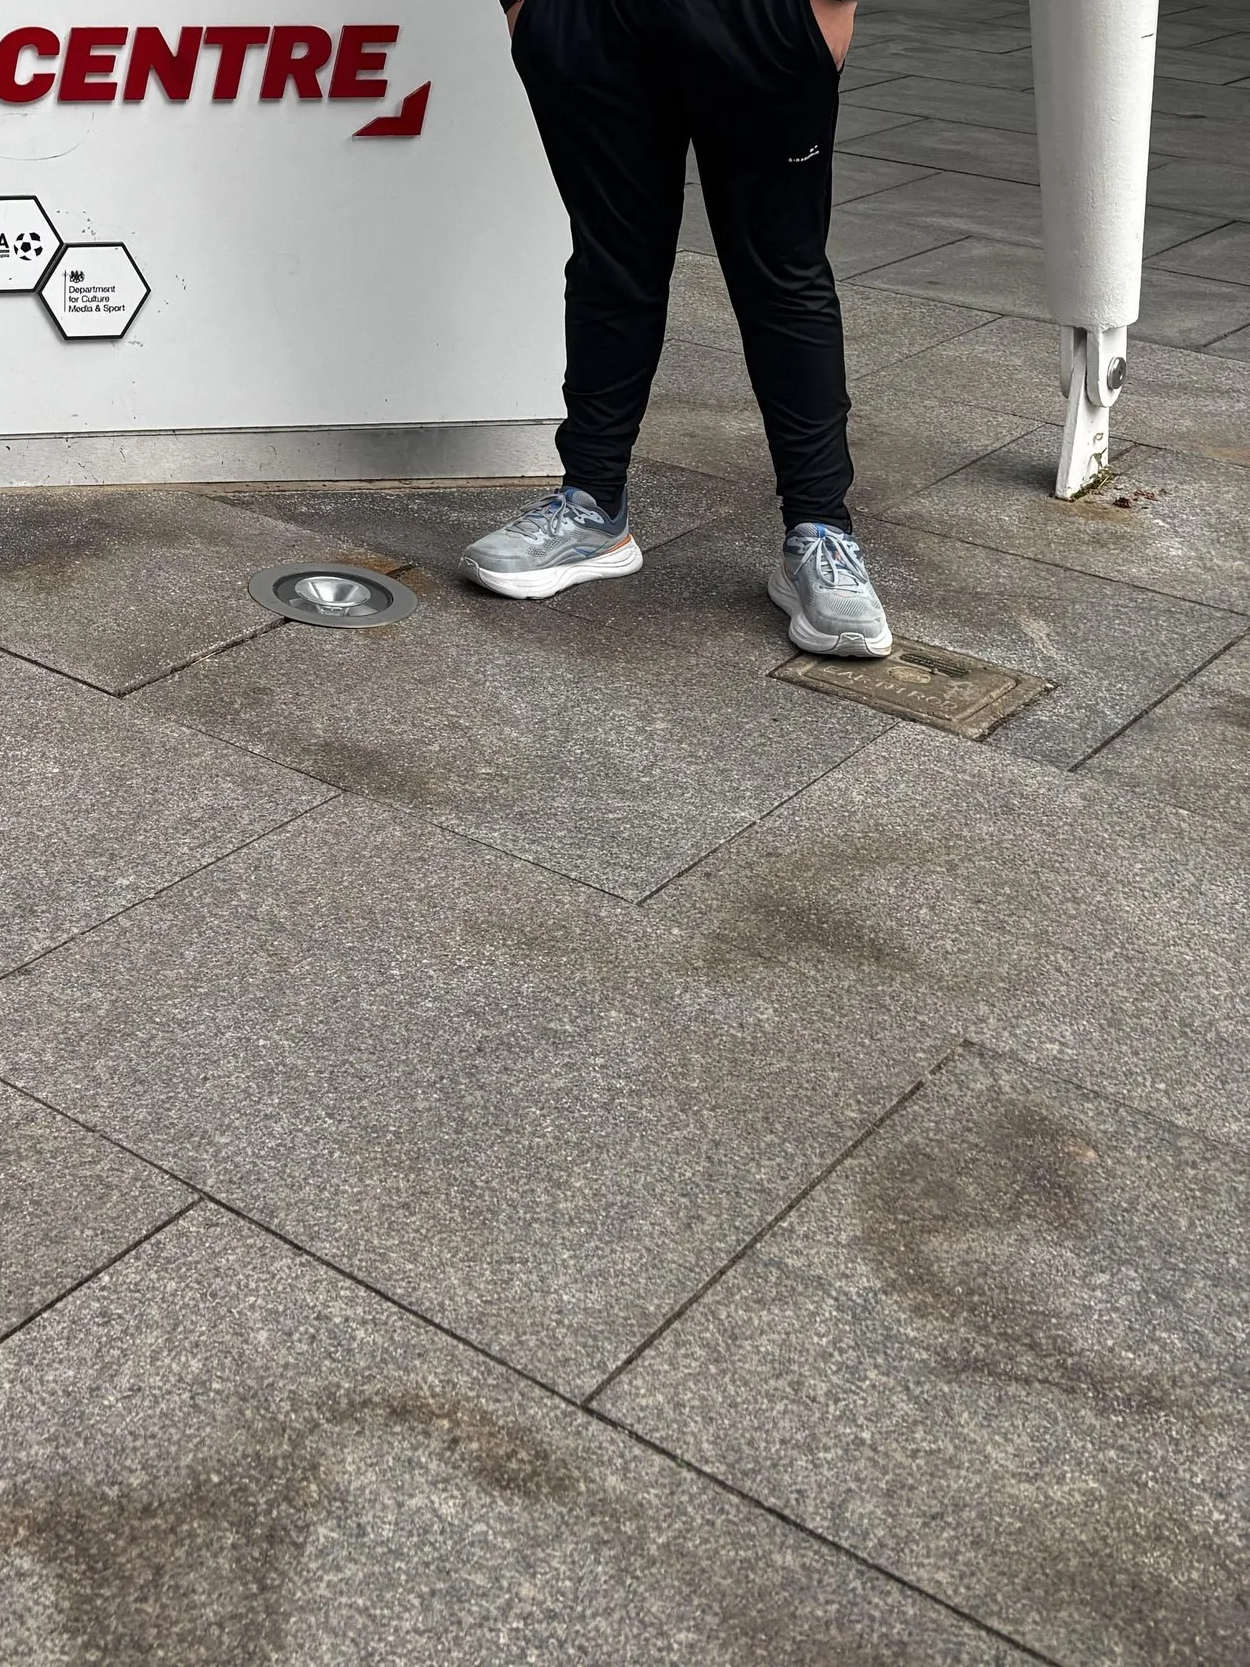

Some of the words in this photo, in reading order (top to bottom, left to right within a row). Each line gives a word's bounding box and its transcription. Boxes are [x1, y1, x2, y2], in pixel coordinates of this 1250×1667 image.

[68, 285, 116, 294] Department
[68, 295, 79, 303] for
[81, 295, 110, 303] Culture
[68, 305, 93, 313] Media
[94, 304, 101, 313] &
[102, 304, 125, 313] Sport
